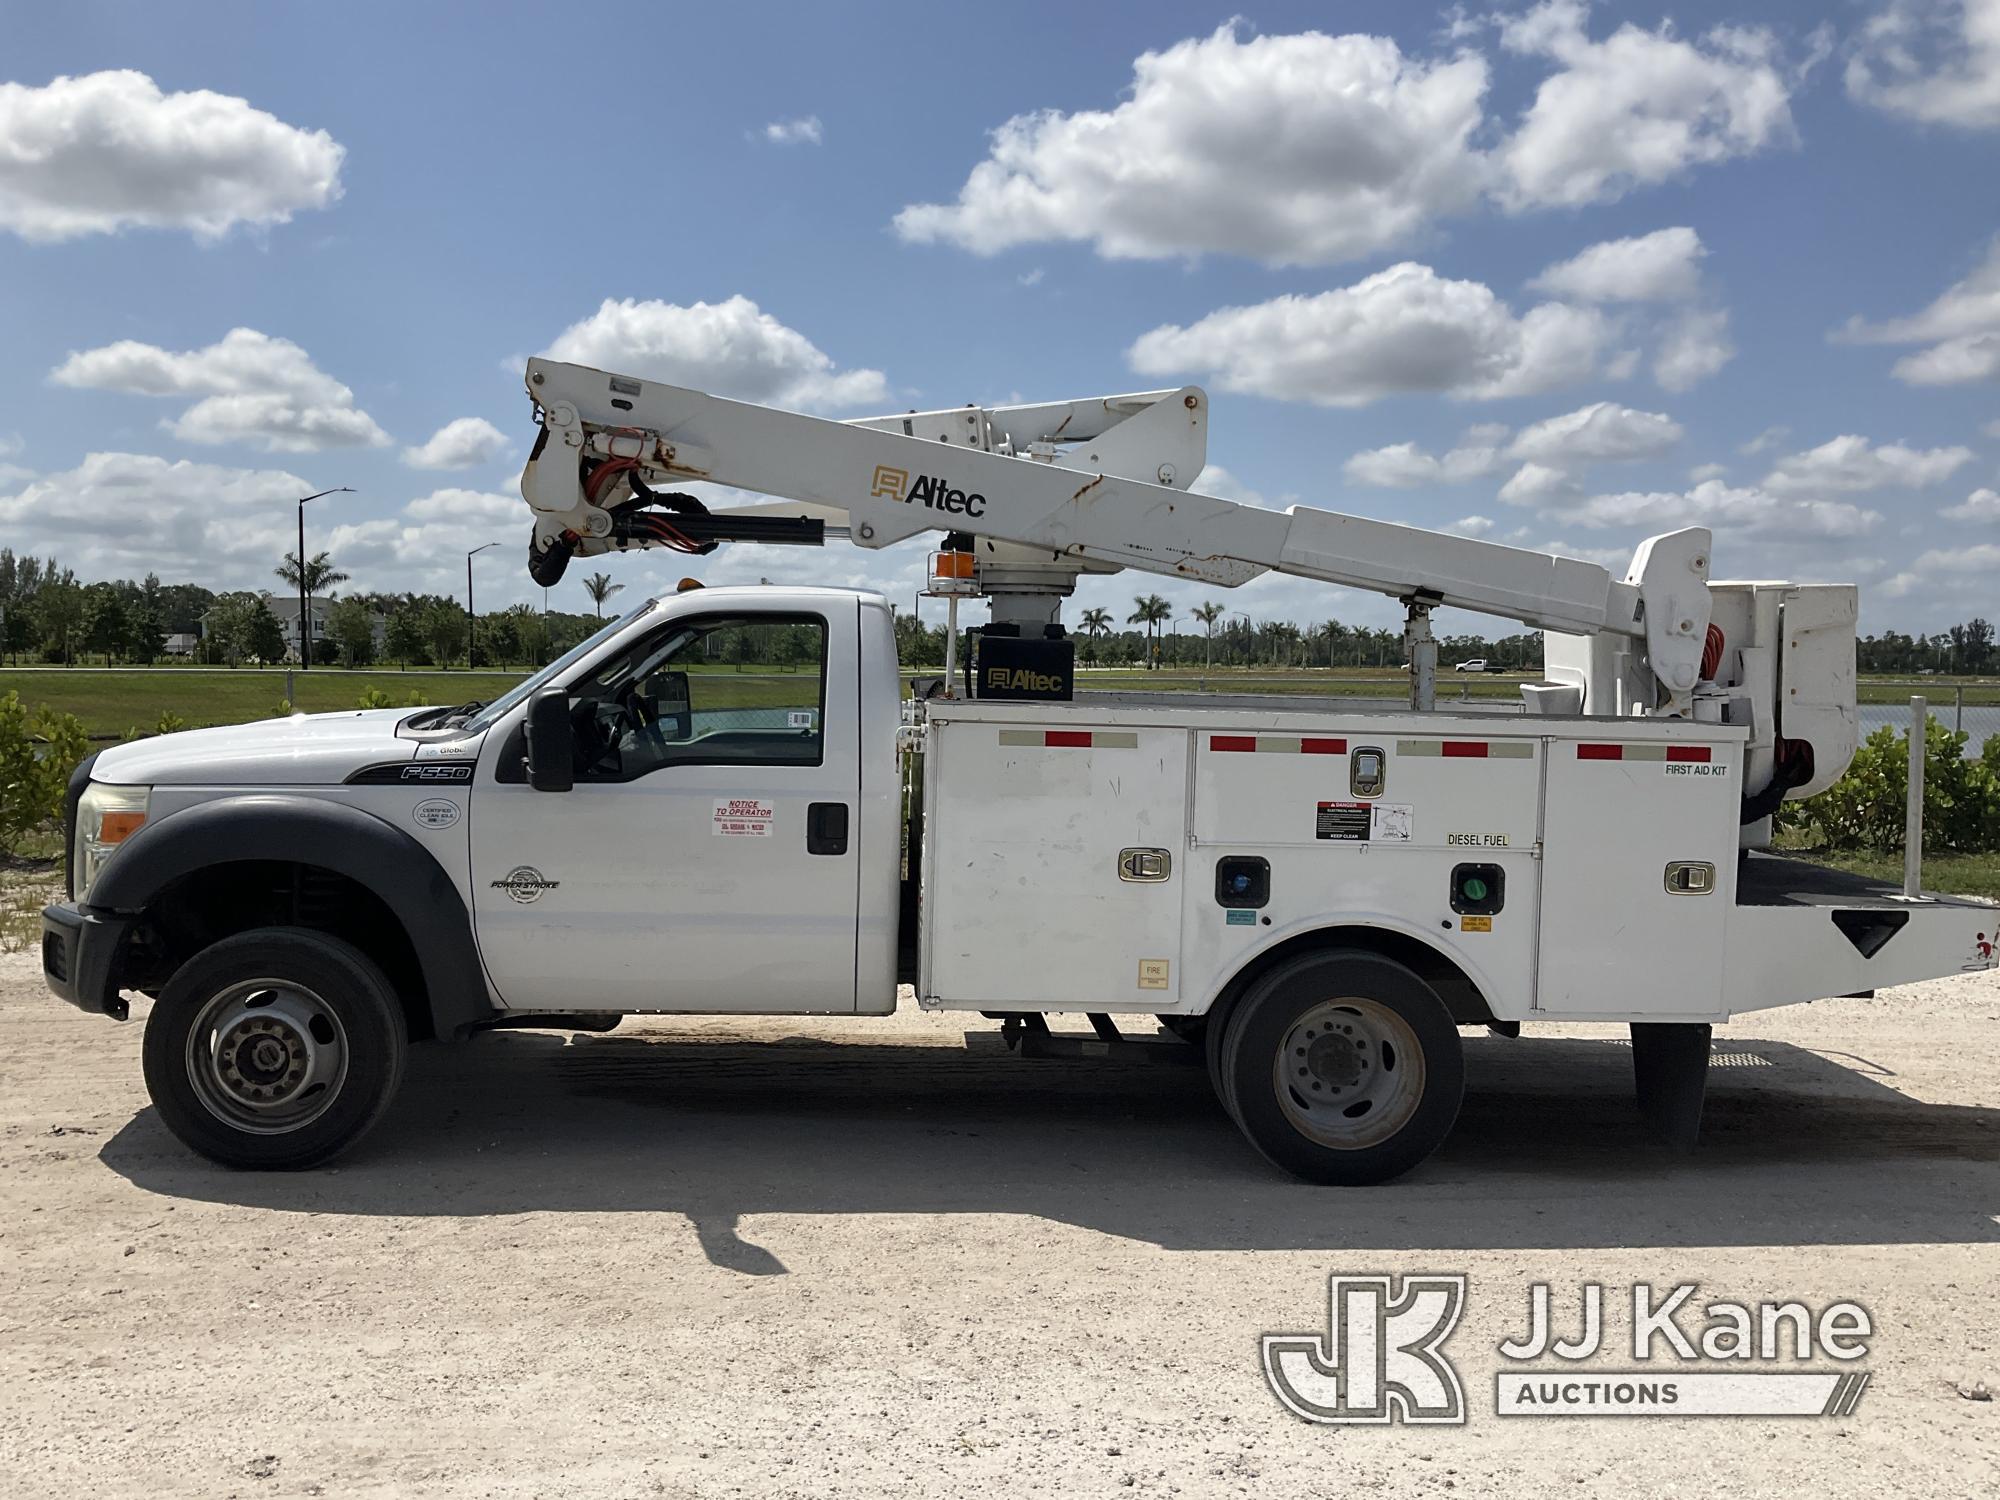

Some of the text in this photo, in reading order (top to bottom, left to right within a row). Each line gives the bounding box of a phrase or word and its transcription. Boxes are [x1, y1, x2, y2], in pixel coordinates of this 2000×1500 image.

[905, 475, 986, 518] Altec
[1010, 670, 1063, 692] Altec
[400, 766, 472, 779] F-550
[1665, 764, 1727, 776] FIRST AID KIT
[729, 800, 759, 808] NOTICE
[1448, 834, 1508, 846] DIESEL FUEL
[1146, 966, 1161, 974] FIRE
